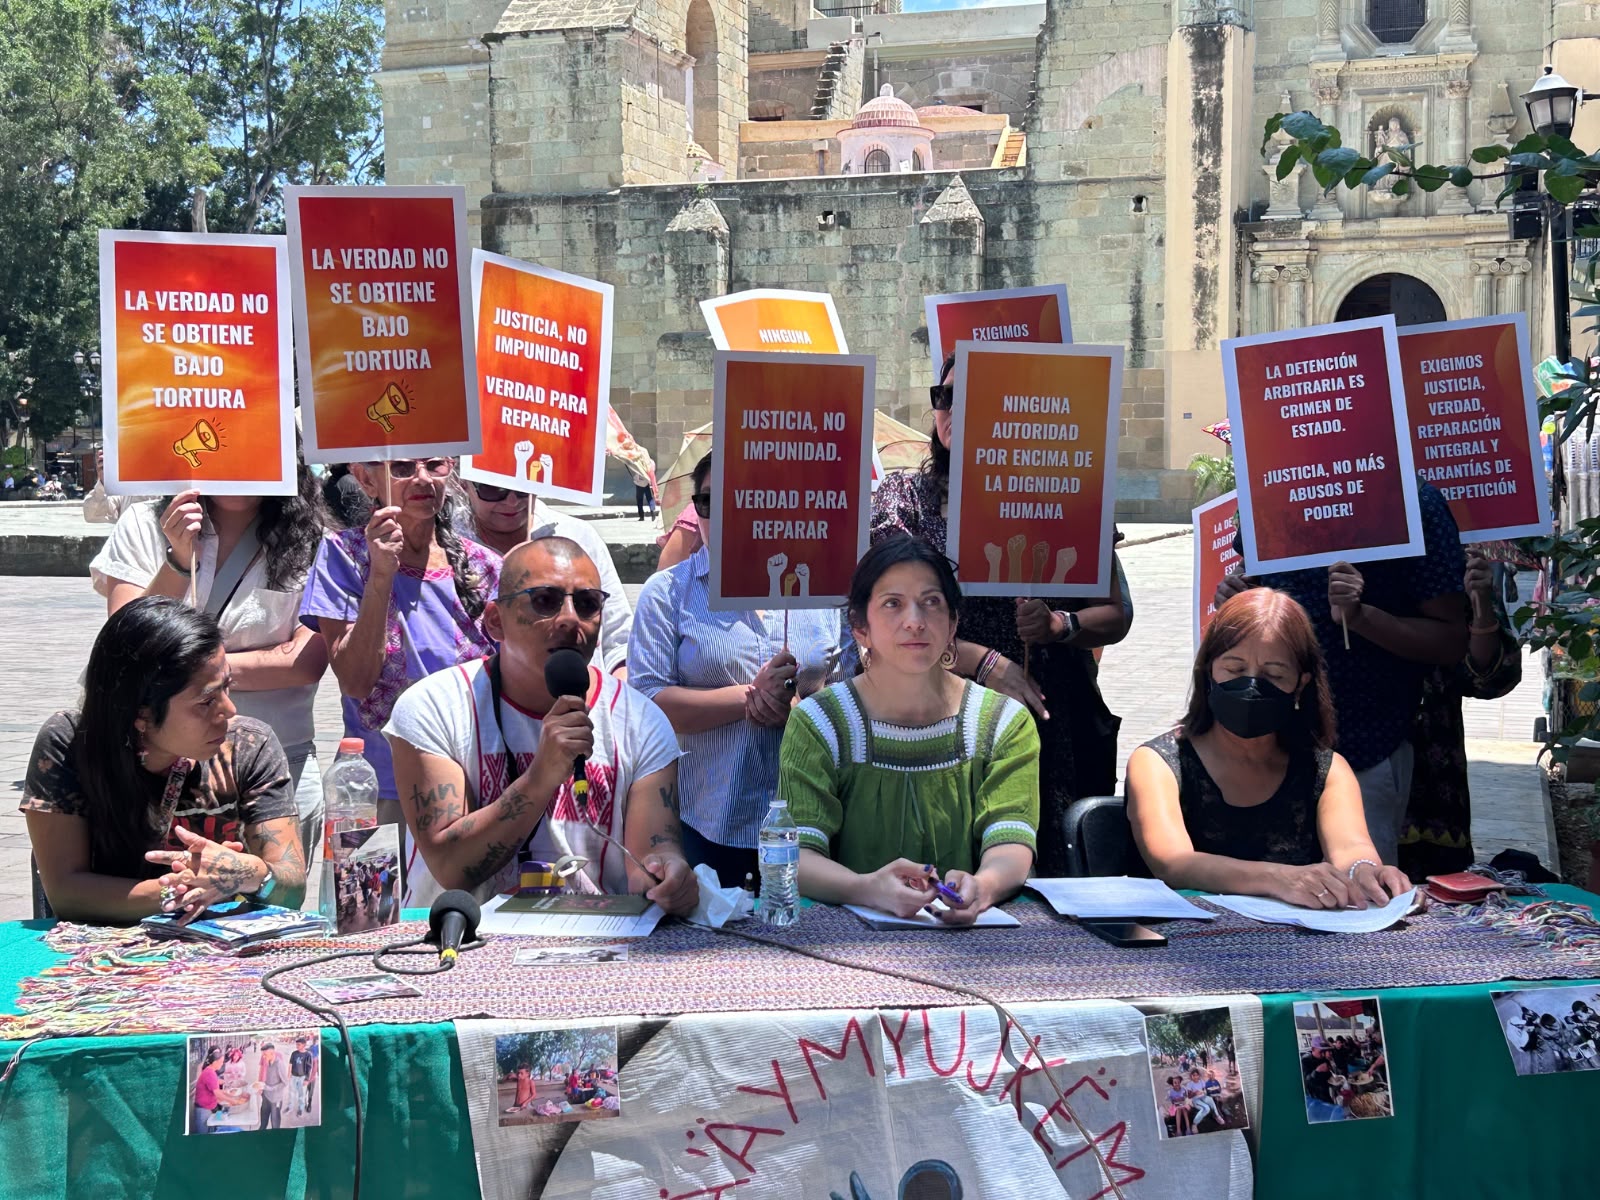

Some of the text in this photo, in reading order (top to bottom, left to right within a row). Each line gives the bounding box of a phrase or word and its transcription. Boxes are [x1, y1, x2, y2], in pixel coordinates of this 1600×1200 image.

[312, 248, 448, 270] LA VERDAD NO
[125, 290, 268, 314] LA VERDAD NO
[330, 282, 436, 304] SE OBTIENE
[142, 323, 254, 345] SE OBTIENE
[362, 315, 409, 337] BAJO
[493, 307, 587, 345] JUSTICIA, NO
[758, 329, 812, 344] NINGUNA
[972, 323, 1029, 341] EXIGIMOS
[343, 348, 431, 372] TORTURA
[495, 335, 584, 372] IMPUNIDAD.
[1420, 354, 1483, 374] EXIGIMOS
[174, 356, 224, 377] BAJO
[1266, 352, 1357, 379] LA DETENCIÓN
[486, 375, 588, 415] VERDAD PARA
[1264, 374, 1365, 401] ARBITRARIA ES
[1424, 376, 1485, 395] JUSTICIA,
[152, 388, 246, 409] TORTURA
[1003, 395, 1070, 414] NINGUNA
[1280, 396, 1353, 419] CRIMEN DE
[1428, 398, 1485, 416] VERDAD,
[501, 406, 570, 438] REPARAR
[741, 409, 845, 433] JUSTICIA, NO
[992, 422, 1079, 440] AUTORIDAD
[1291, 419, 1346, 438] ESTADO.
[1417, 414, 1501, 439] REPARACIÓN
[744, 441, 841, 461] IMPUNIDAD.
[976, 448, 1093, 467] POR ENCIMA DE
[1425, 438, 1499, 460] INTEGRAL Y
[1263, 453, 1385, 487] ¡JUSTICIA, NO MÁS
[1417, 459, 1512, 481] GARANTÍAS DE
[985, 475, 1080, 493] LA DIGNIDAD
[1289, 480, 1365, 502] ABUSOS DE
[1440, 477, 1517, 501] REPETICIÓN
[735, 489, 848, 509] VERDAD PARA
[1000, 502, 1063, 519] HUMANA
[1304, 502, 1353, 522] PODER!
[753, 520, 828, 539] REPARAR
[1214, 522, 1223, 534] LA
